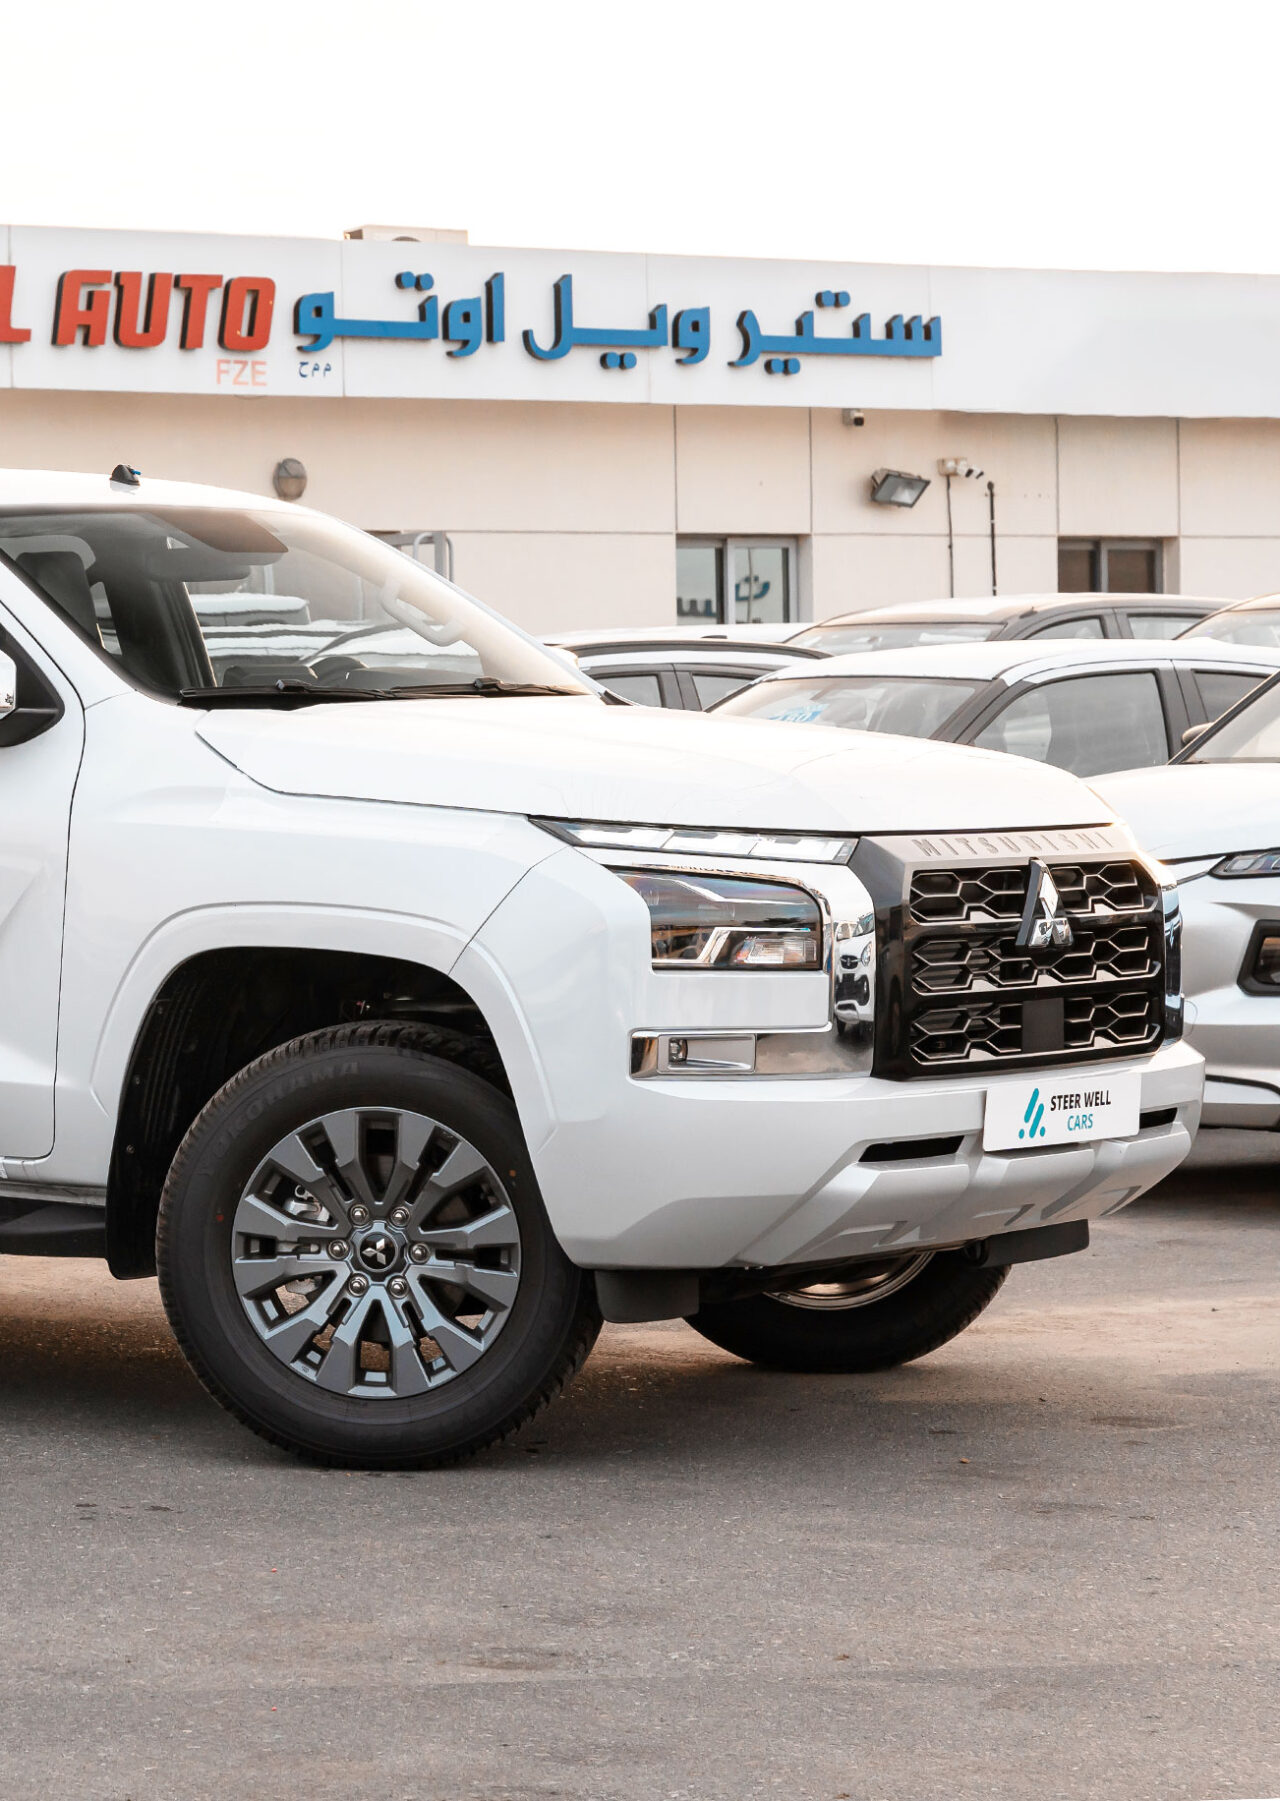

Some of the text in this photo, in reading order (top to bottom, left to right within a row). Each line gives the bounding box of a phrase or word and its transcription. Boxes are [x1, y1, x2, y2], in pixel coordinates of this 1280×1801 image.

[51, 269, 276, 352] AUTO
[293, 270, 943, 376] ستير ويل اوتو
[216, 358, 268, 387] FZE
[911, 831, 1114, 857] MITSUBISHI
[1050, 1090, 1112, 1112] STEER WELL
[1067, 1113, 1094, 1131] CARS
